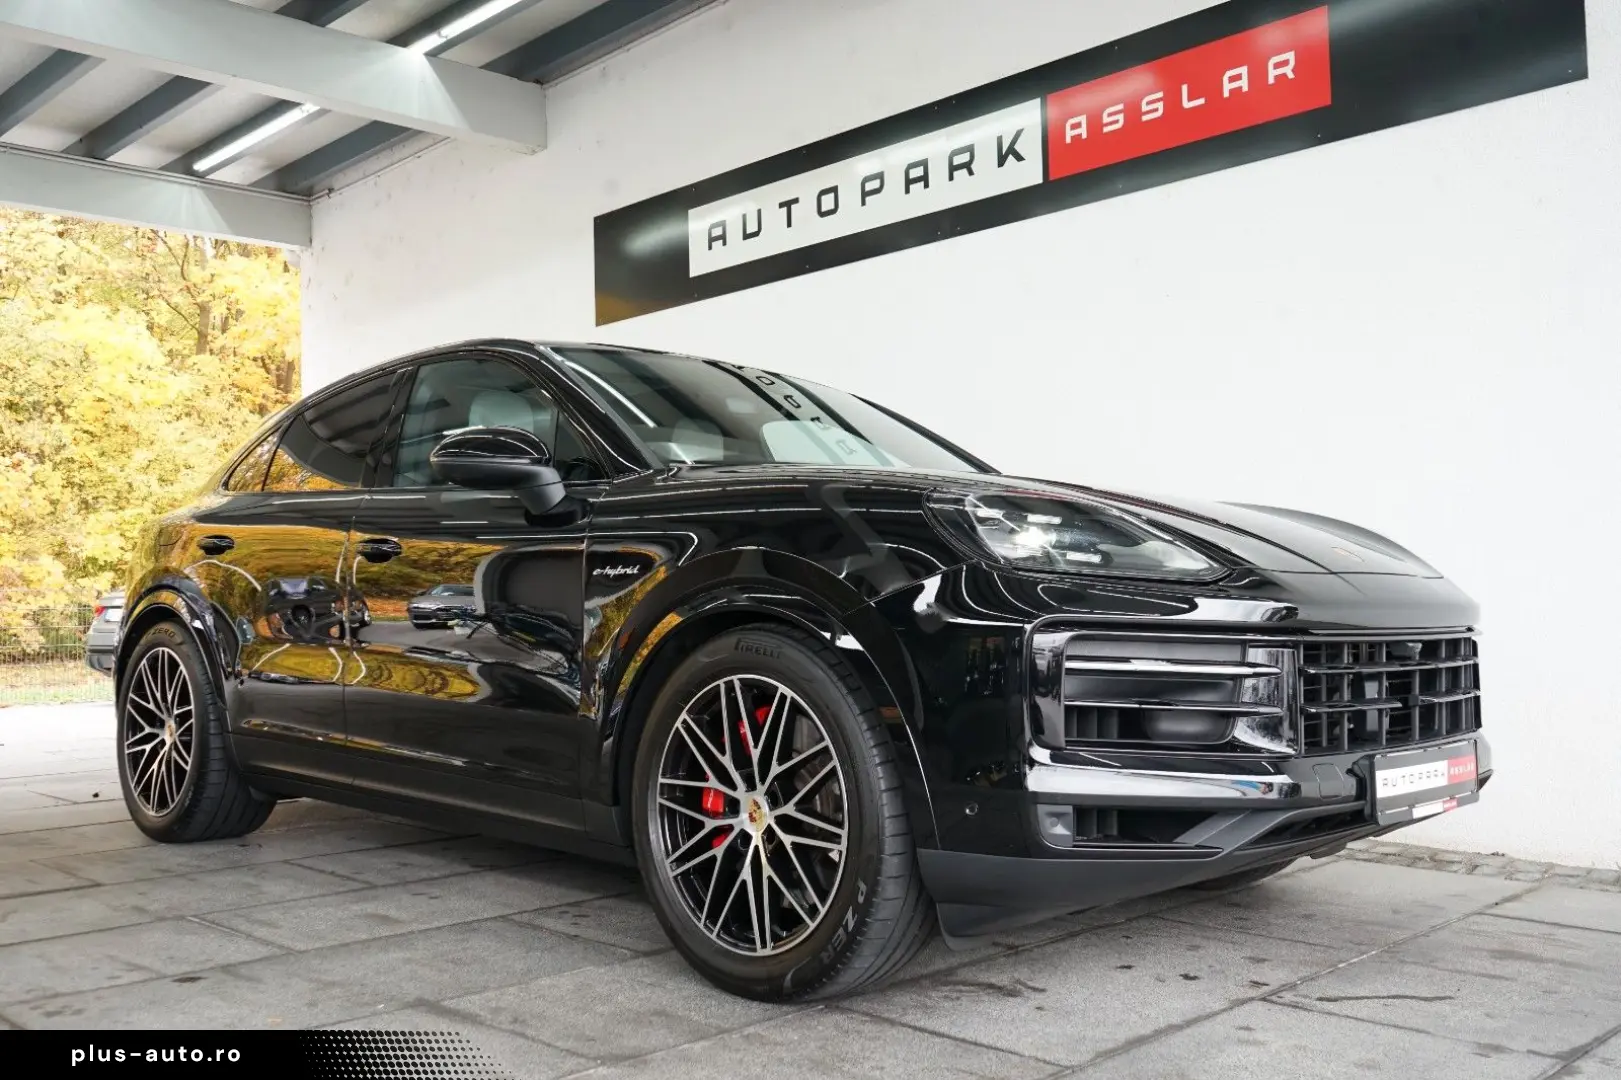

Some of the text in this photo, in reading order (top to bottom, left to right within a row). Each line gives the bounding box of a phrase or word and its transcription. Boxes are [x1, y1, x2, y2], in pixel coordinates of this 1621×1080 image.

[708, 50, 1296, 251] AUTOPARK ASSLAR
[592, 565, 640, 578] e-hybrid
[734, 637, 781, 659] PIRELLI
[818, 877, 867, 967] P ZER
